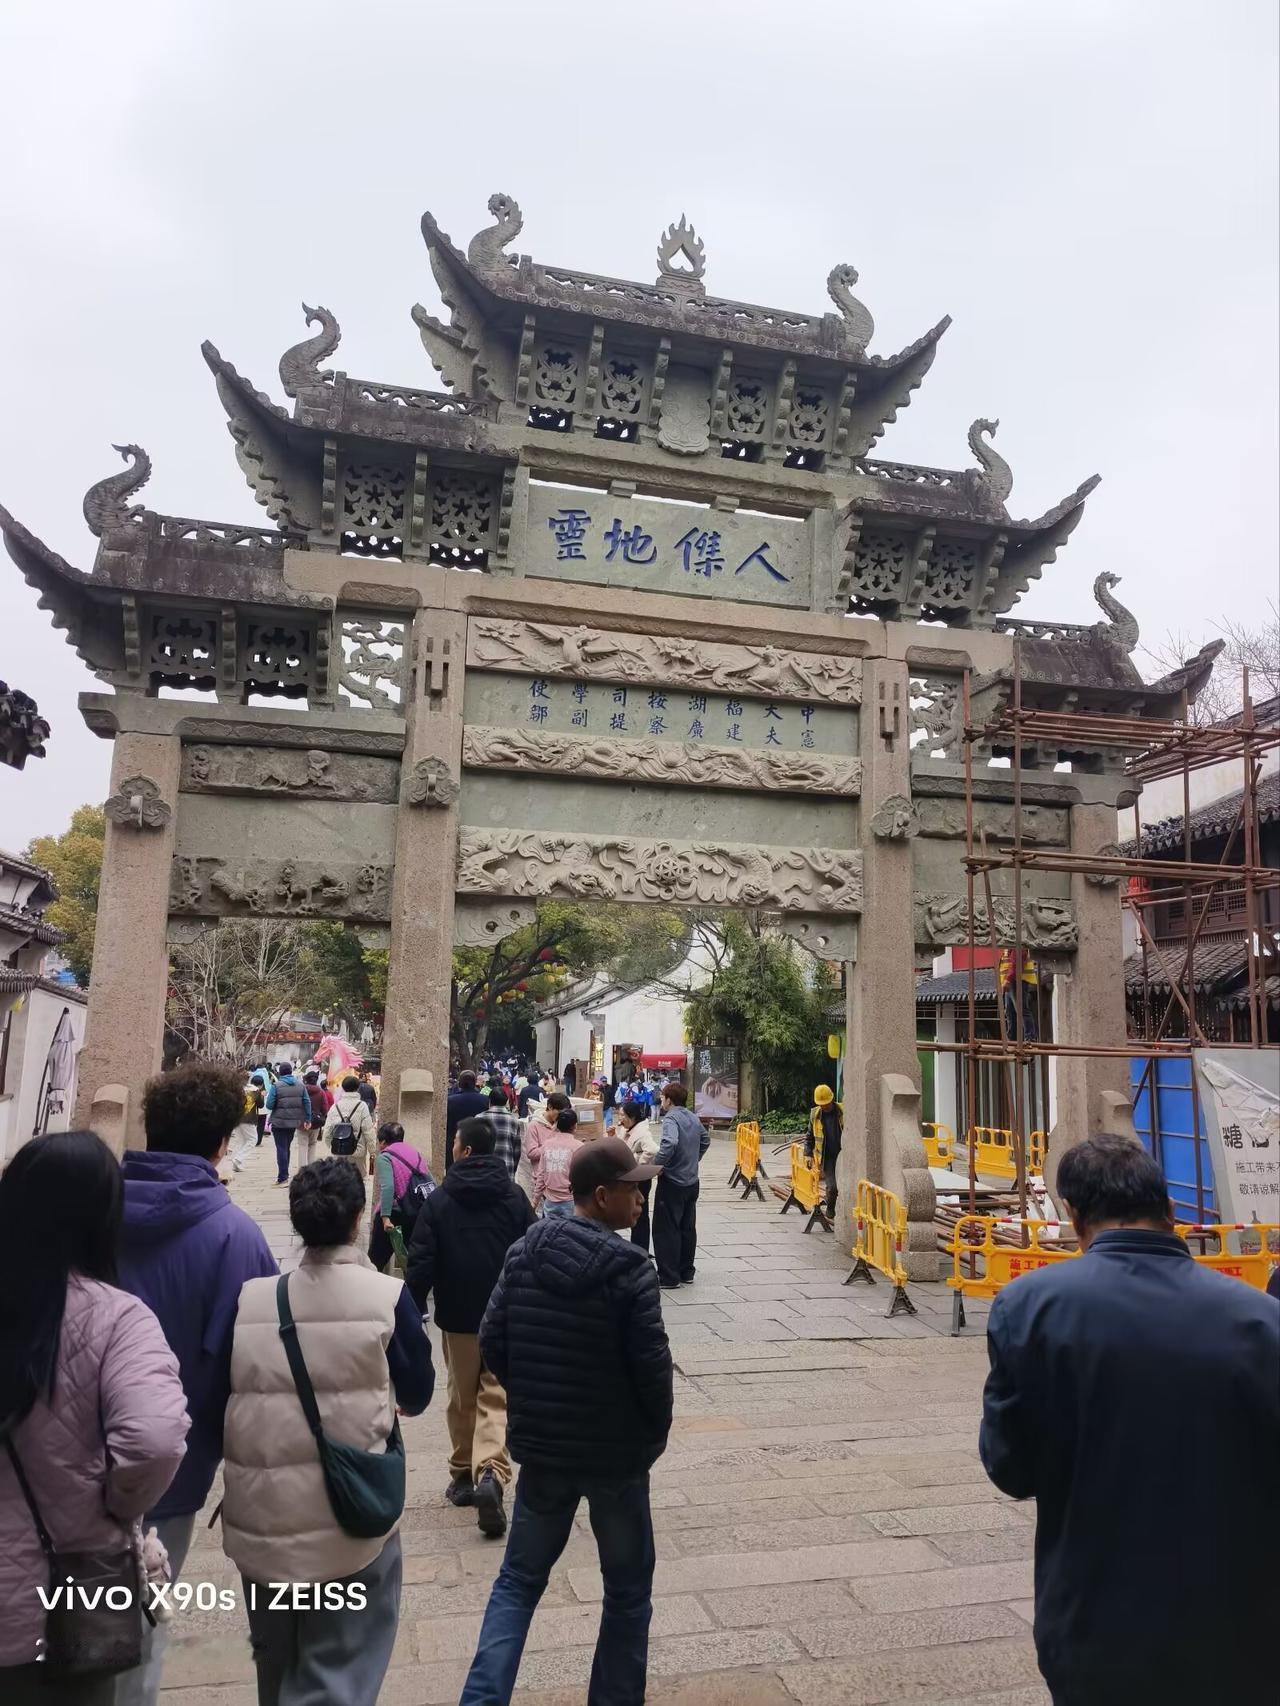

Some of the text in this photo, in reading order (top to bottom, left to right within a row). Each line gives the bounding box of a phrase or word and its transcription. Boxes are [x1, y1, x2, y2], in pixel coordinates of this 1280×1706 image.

[610, 687, 629, 730] 司提
[648, 690, 669, 735] 按察
[763, 703, 783, 745] 大夫
